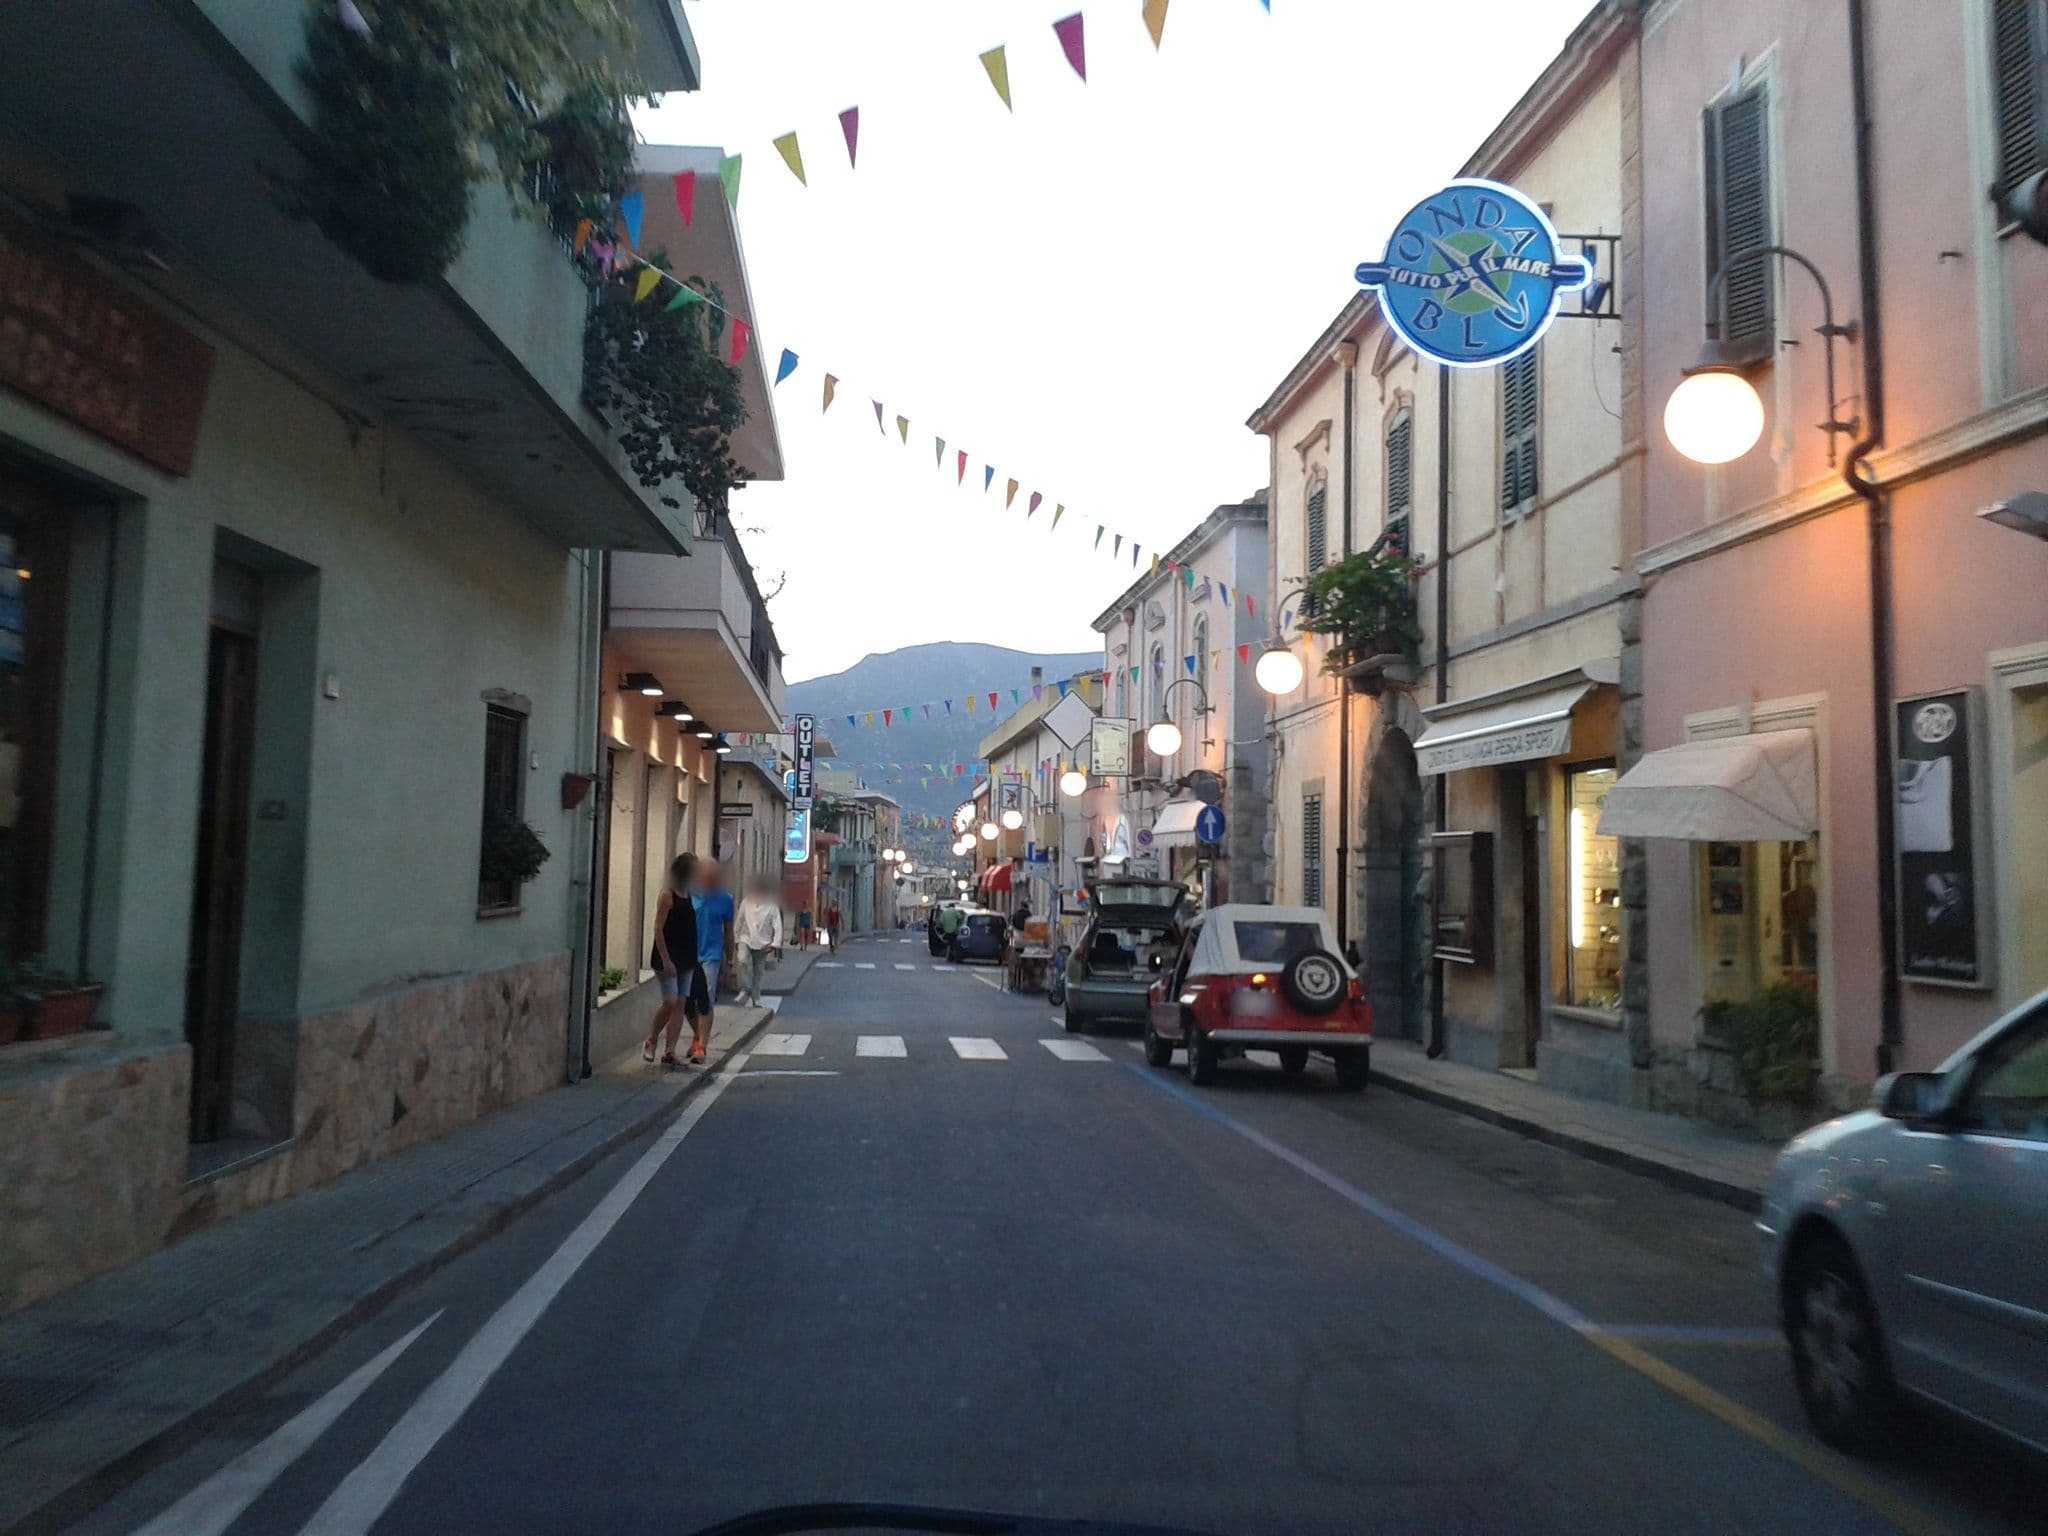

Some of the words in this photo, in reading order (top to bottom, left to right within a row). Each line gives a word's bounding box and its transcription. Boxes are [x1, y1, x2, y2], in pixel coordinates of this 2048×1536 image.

[1398, 197, 1537, 262] ONDA
[1389, 266, 1441, 289] TUTTO
[1446, 265, 1479, 286] PER
[1480, 258, 1501, 274] IL
[1503, 256, 1551, 278] MARE
[1413, 292, 1528, 348] BLU
[800, 719, 812, 796] OUTLET
